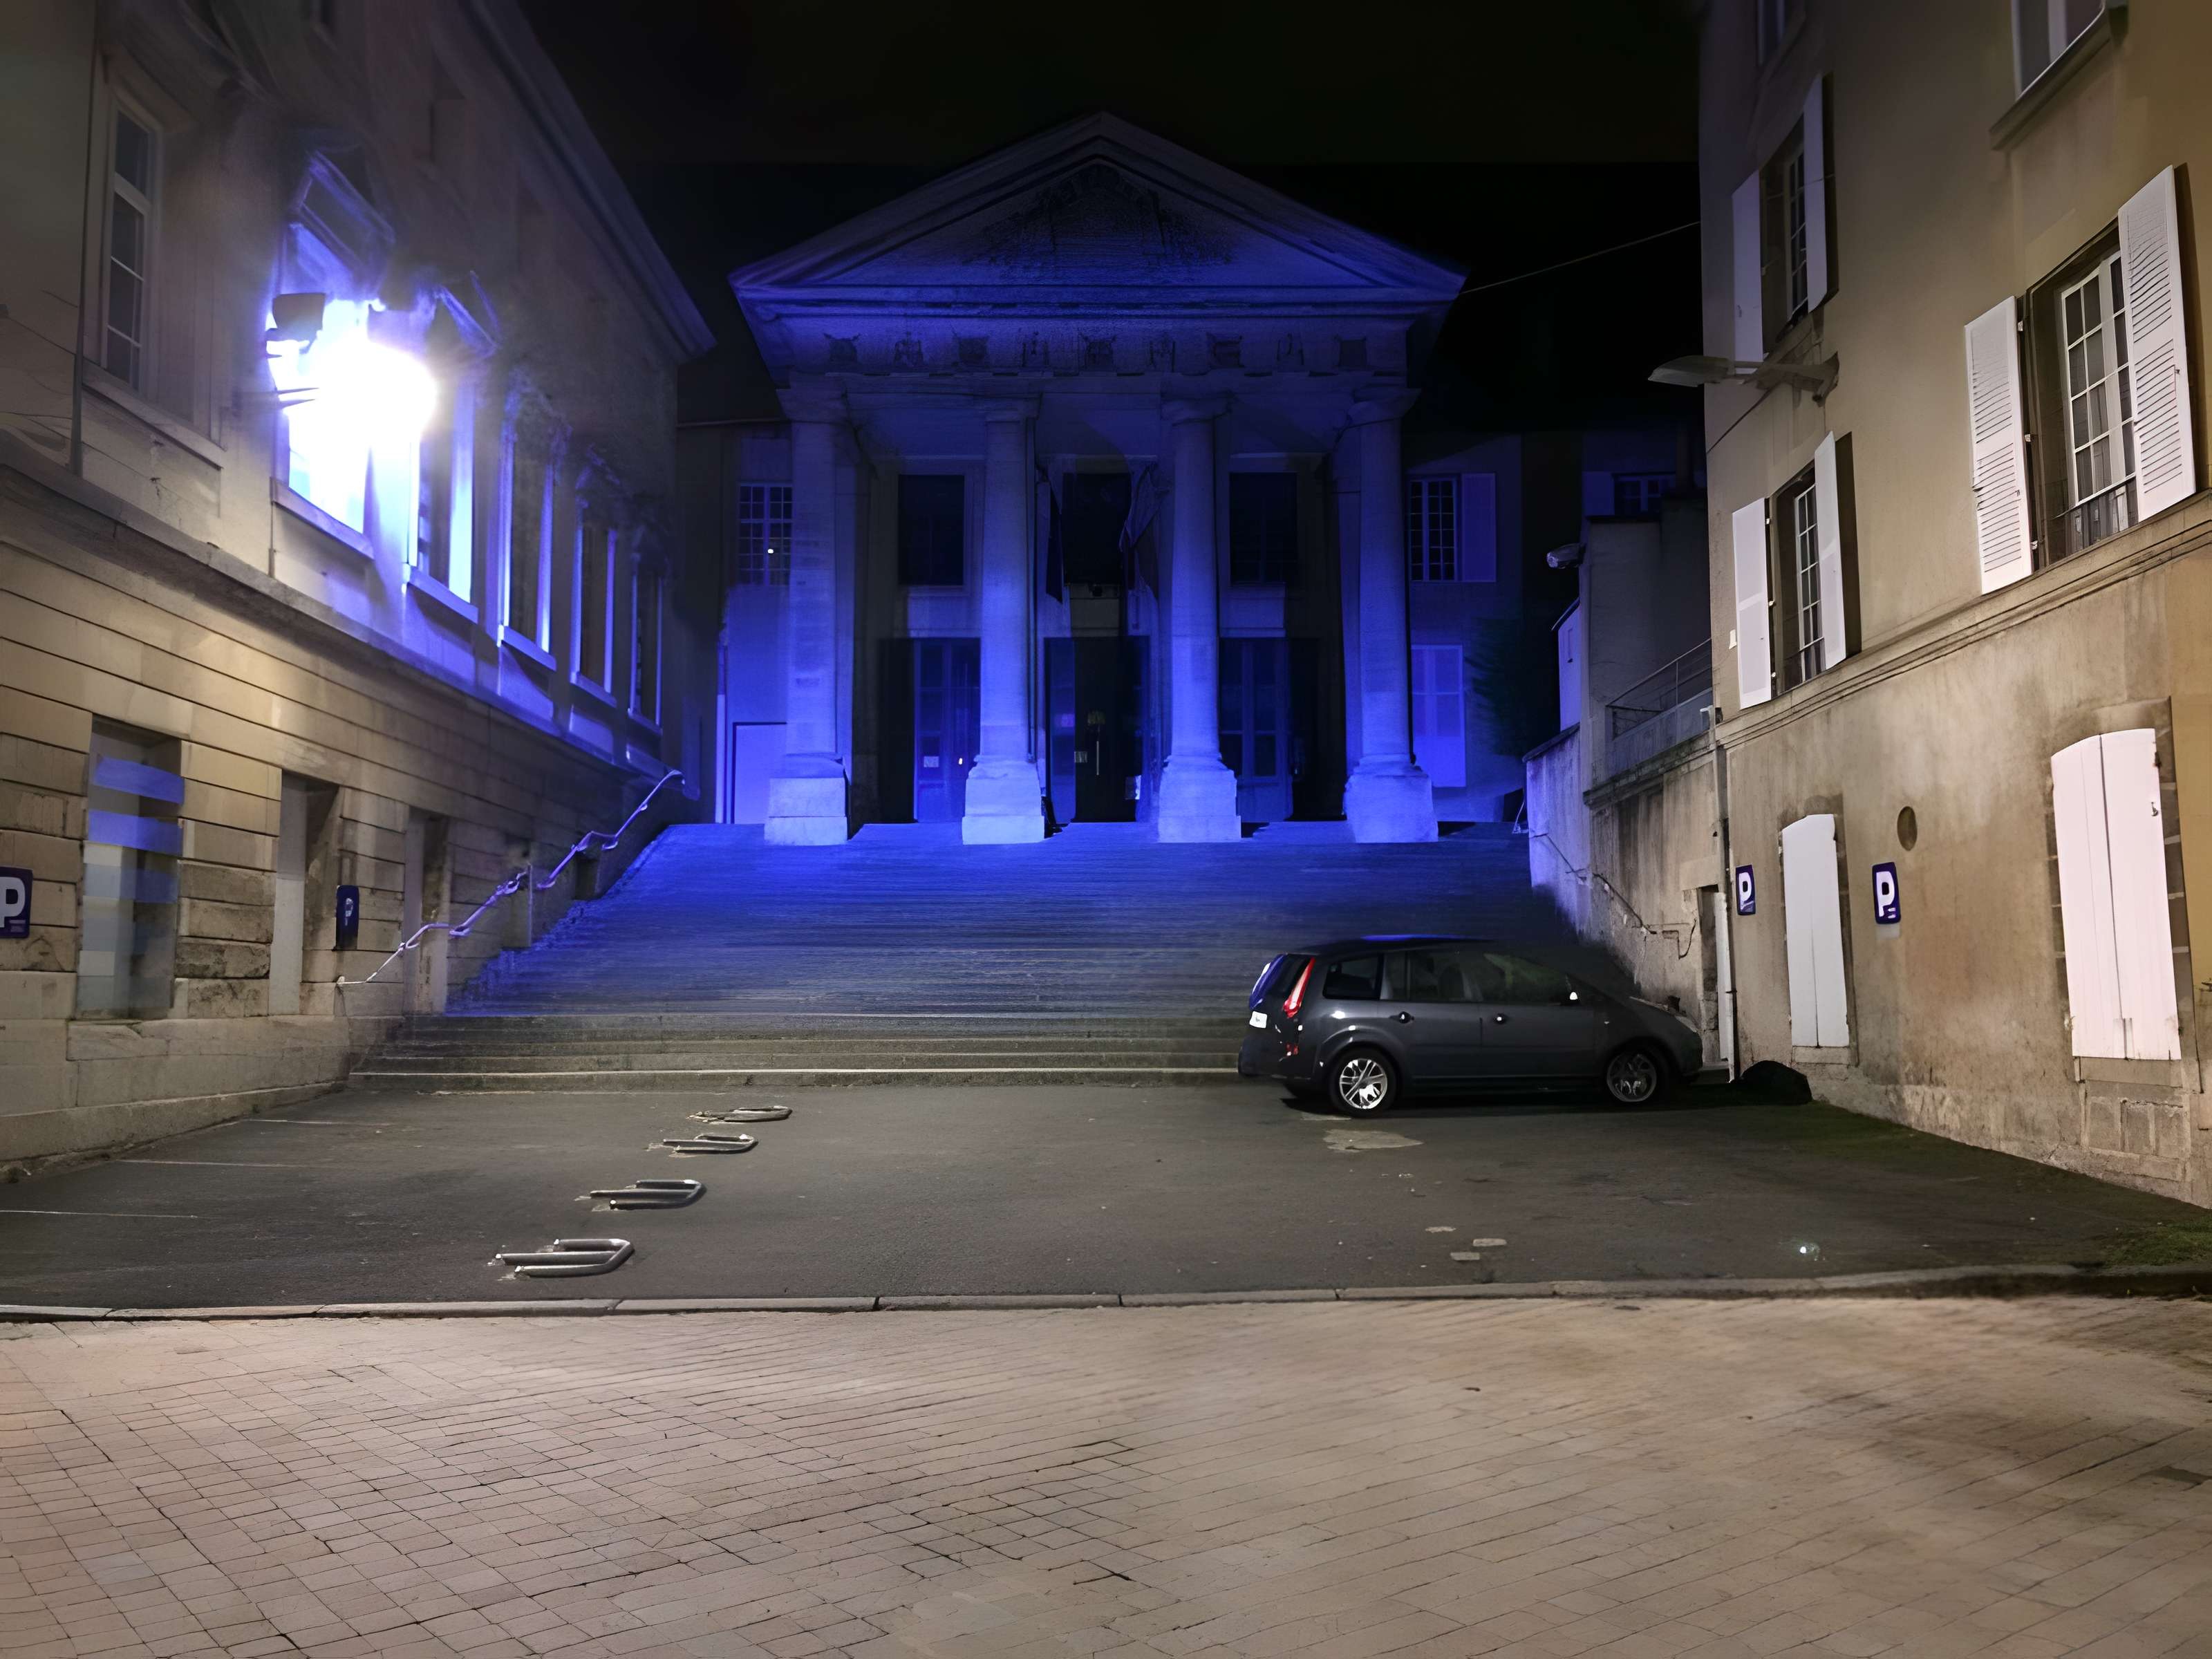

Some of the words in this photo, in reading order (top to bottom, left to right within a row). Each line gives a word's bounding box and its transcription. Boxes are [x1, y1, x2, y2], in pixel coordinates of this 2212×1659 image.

[0, 877, 26, 928] P
[1738, 872, 1752, 910] P
[1876, 871, 1895, 917] P
